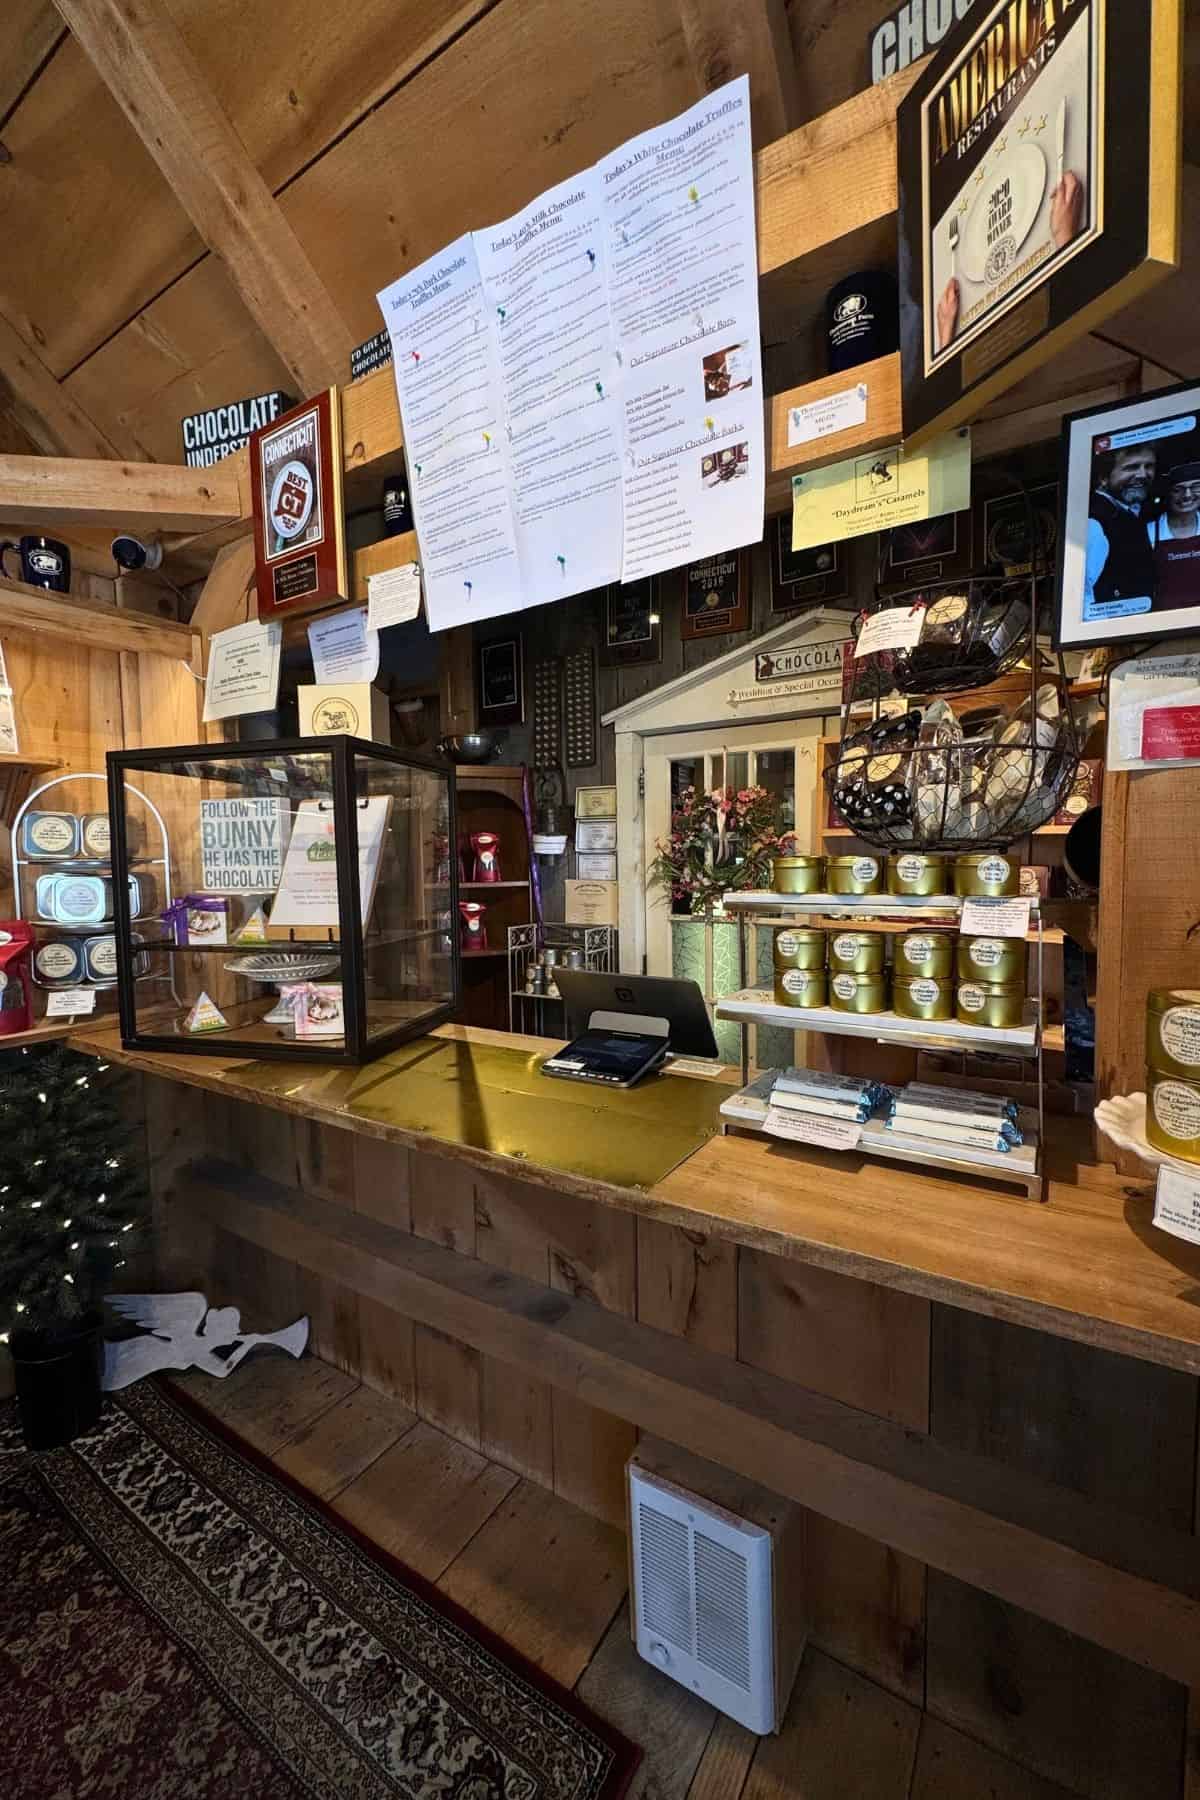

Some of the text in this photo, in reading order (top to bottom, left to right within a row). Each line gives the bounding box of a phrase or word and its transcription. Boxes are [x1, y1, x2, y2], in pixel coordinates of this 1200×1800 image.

[936, 0, 1077, 165] AMERICA
[956, 31, 1056, 160] RESTAURANTS
[603, 98, 743, 184] Today's White Chocolate Truffles
[547, 191, 586, 217] Chocolate
[988, 196, 1012, 230] AWARD
[679, 326, 717, 346] Chocolate
[183, 393, 279, 449] CHOCOLATE
[186, 437, 250, 469] UNDER
[264, 423, 314, 464] CONNECTICUT
[288, 471, 308, 489] BEST
[282, 493, 302, 514] CT
[886, 488, 926, 505] Caramels
[689, 561, 737, 581] CONNECTICUT
[738, 686, 774, 700] Wedding
[784, 679, 815, 695] Special
[202, 799, 277, 818] FOLLOW THE
[203, 820, 277, 848] BUNNY
[204, 850, 279, 867] HE HAS THE
[205, 870, 280, 888] CHOCOLATE
